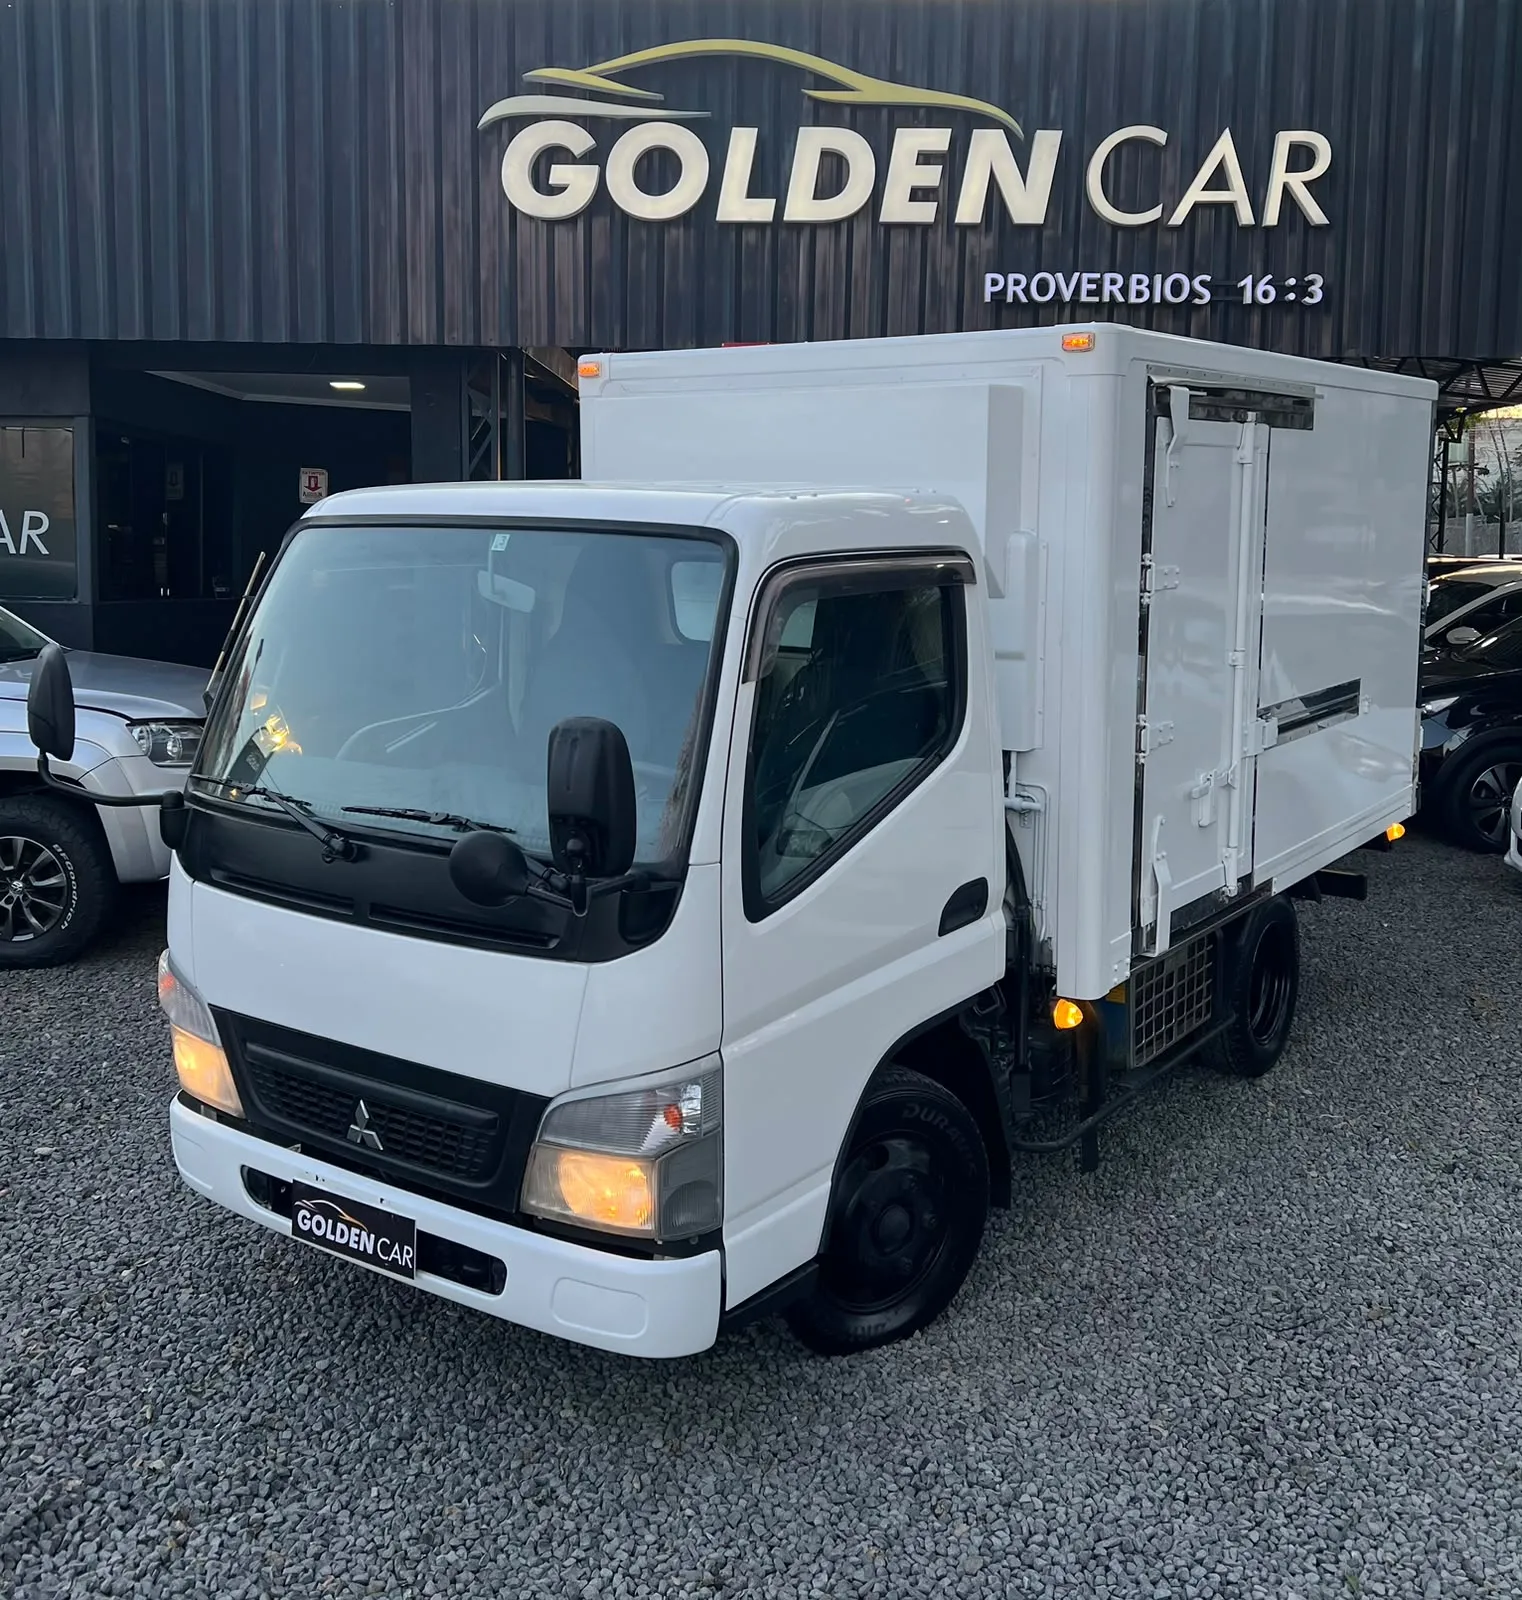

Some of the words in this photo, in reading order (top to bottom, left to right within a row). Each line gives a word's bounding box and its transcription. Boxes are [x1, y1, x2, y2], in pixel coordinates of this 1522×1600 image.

[500, 119, 1063, 227] GOLDEN
[1086, 125, 1333, 228] CAR
[983, 272, 1212, 305] PROVERBIOS
[297, 1208, 376, 1255] GOLDEN
[376, 1237, 414, 1269] CAR
